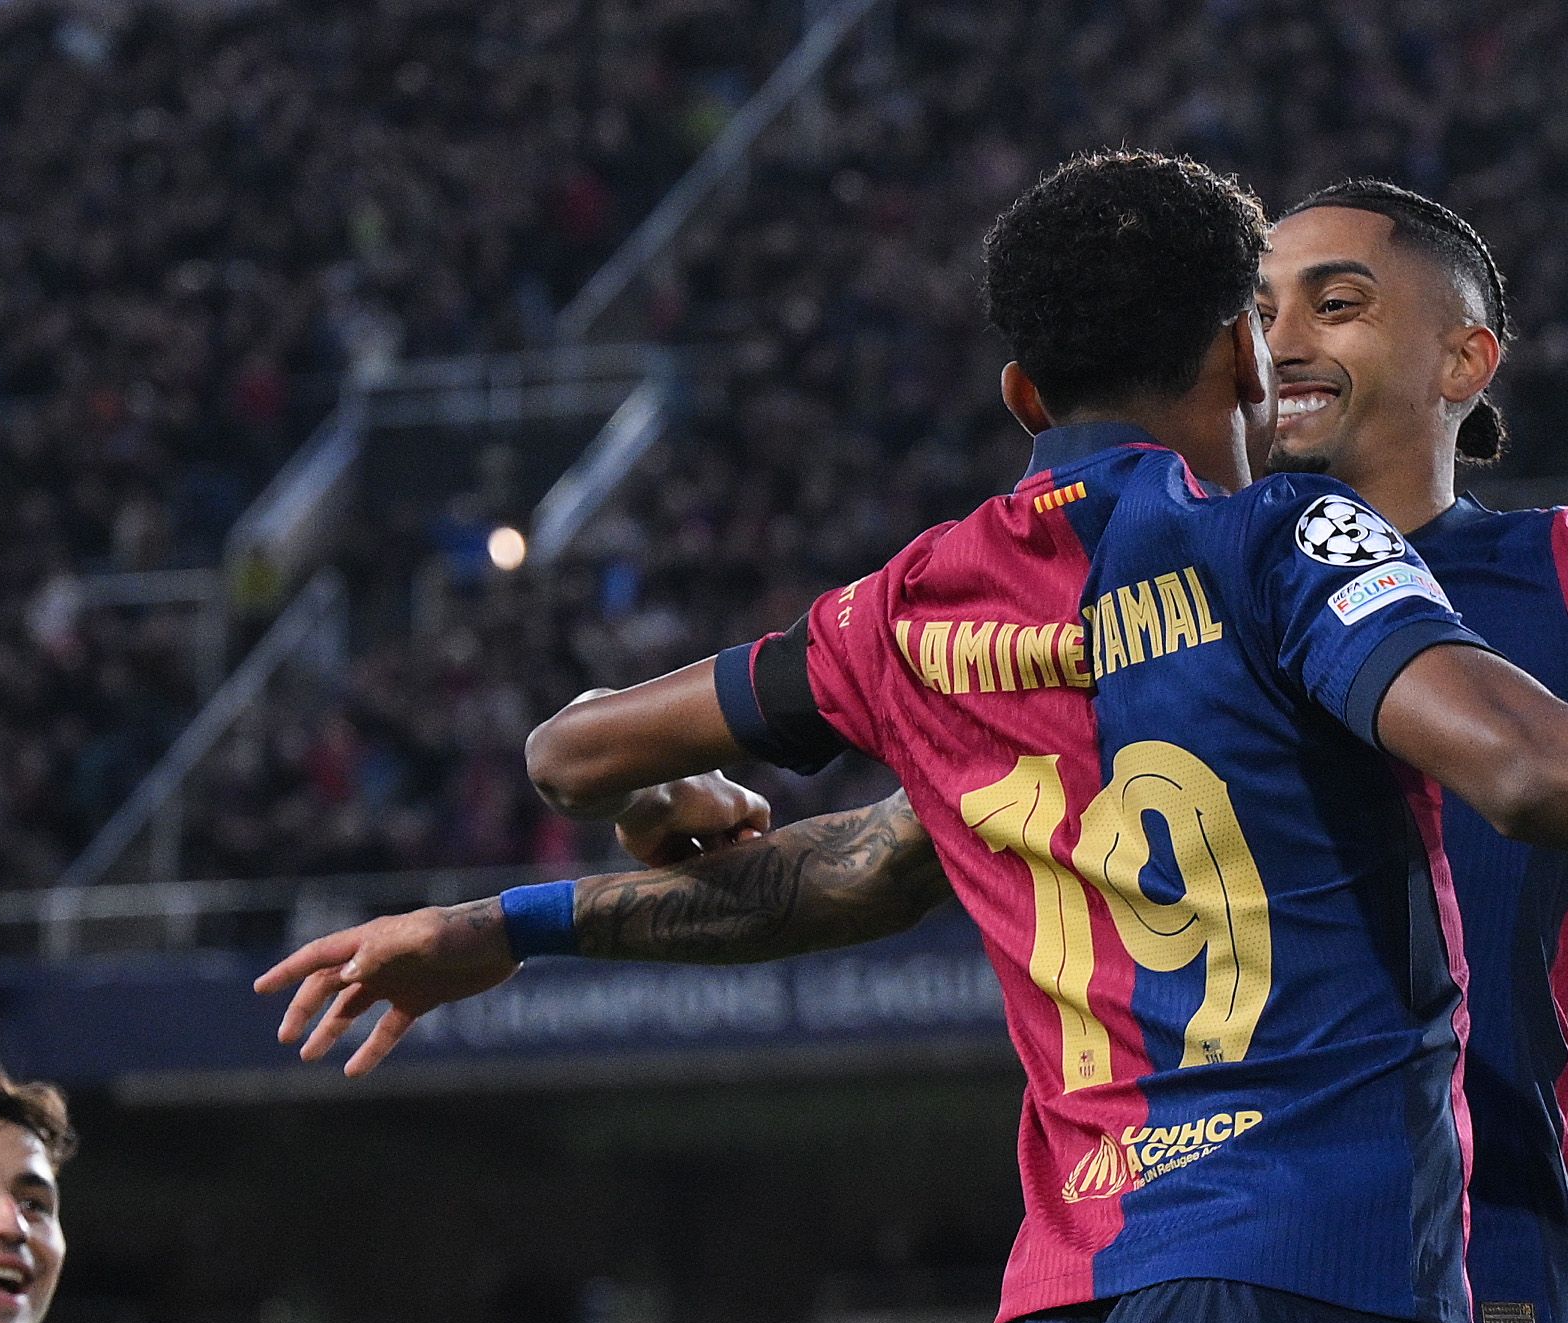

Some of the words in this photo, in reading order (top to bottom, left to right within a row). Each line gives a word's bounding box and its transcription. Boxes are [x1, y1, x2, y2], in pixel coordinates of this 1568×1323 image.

[1333, 514, 1369, 543] 5
[1333, 582, 1360, 603] UEFA
[895, 620, 1094, 694] LAMINE
[1082, 566, 1223, 680] YAMAL
[961, 740, 1272, 1095] 19
[1143, 1165, 1158, 1184] UN
[1156, 1151, 1201, 1178] Refugee
